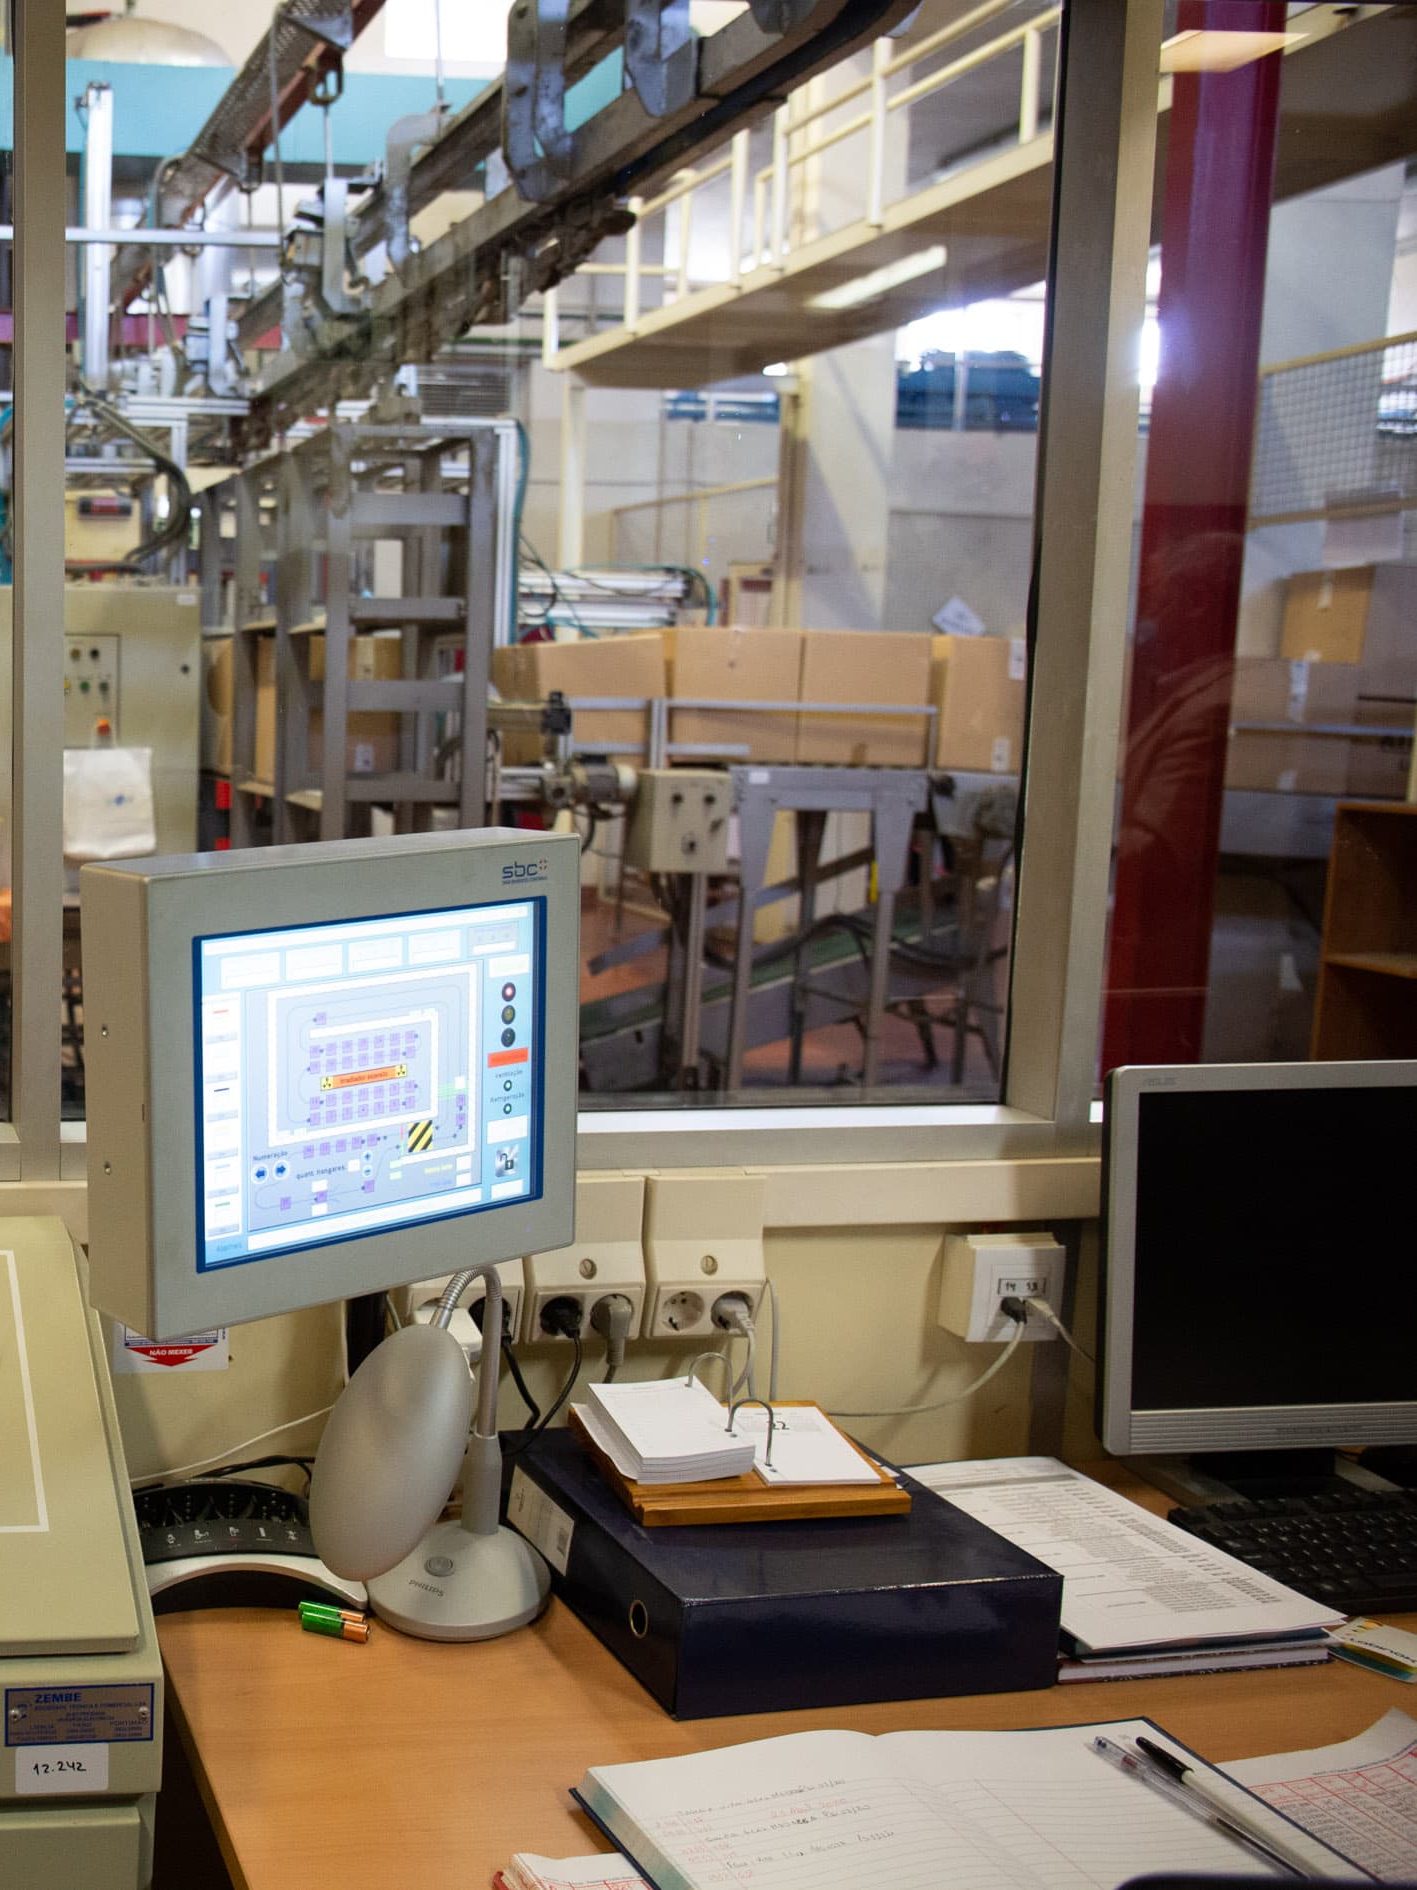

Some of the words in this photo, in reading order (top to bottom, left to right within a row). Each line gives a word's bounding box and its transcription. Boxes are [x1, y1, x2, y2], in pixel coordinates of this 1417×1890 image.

[501, 860, 538, 879] sbc
[252, 1150, 288, 1161] Numeração
[408, 1579, 446, 1597] PHILIPS
[34, 1692, 82, 1704] ZEMBE
[32, 1760, 87, 1776] 12.242
